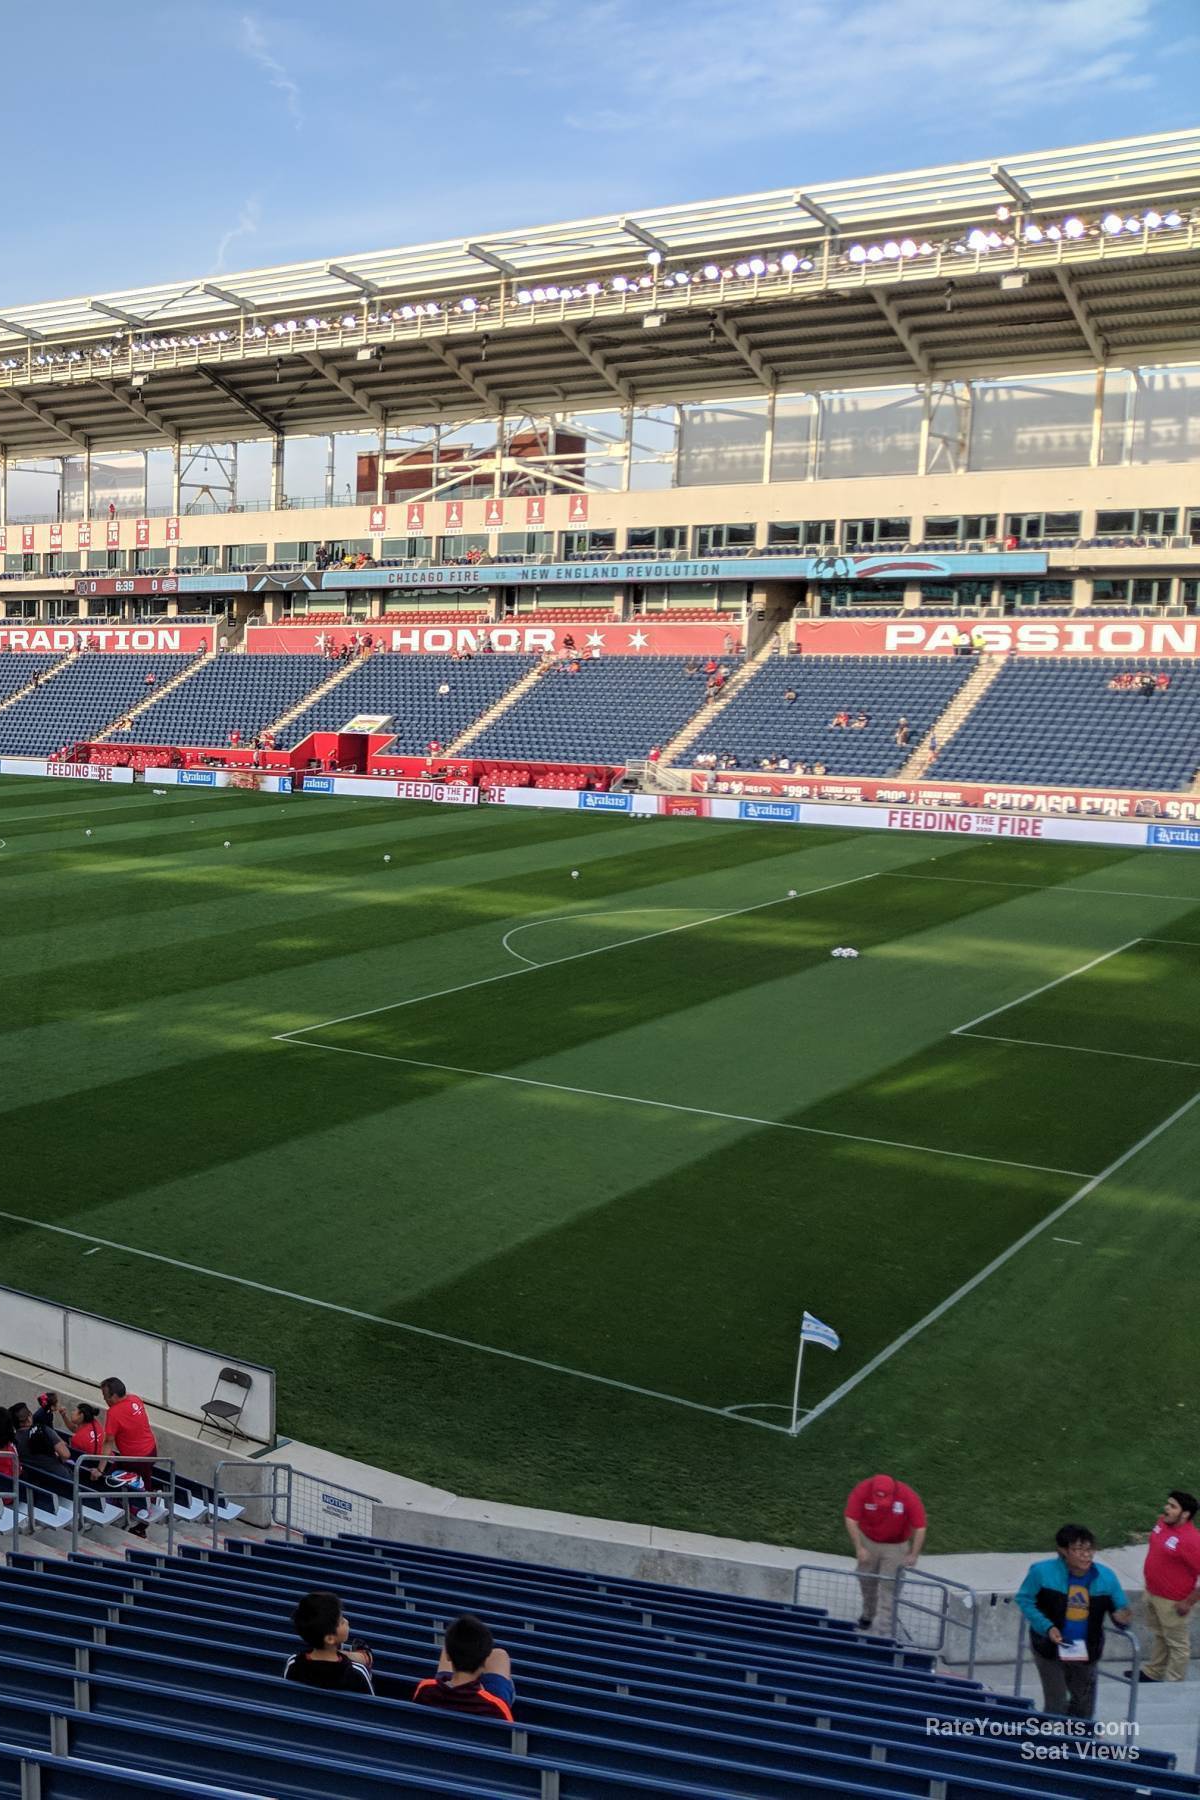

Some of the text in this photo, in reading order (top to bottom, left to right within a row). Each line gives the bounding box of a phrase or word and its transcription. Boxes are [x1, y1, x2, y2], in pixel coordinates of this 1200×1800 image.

[25, 535, 31, 545] 5
[139, 529, 146, 540] 2
[388, 571, 444, 583] CHICAGO
[450, 570, 480, 582] FIRE
[521, 568, 549, 580] NEW
[556, 567, 619, 579] ENGLAND
[626, 564, 721, 578] REVOLUTION
[90, 580, 158, 592] 0 6:39 0
[392, 629, 556, 651] HONOR
[885, 624, 1197, 652] PASSION
[46, 763, 89, 778] FEEDING
[983, 791, 1076, 813] CHICAGO
[1079, 796, 1131, 816] FIRE
[887, 809, 1043, 837] FEEDING THE FIRE
[323, 1495, 351, 1509] NOTICE
